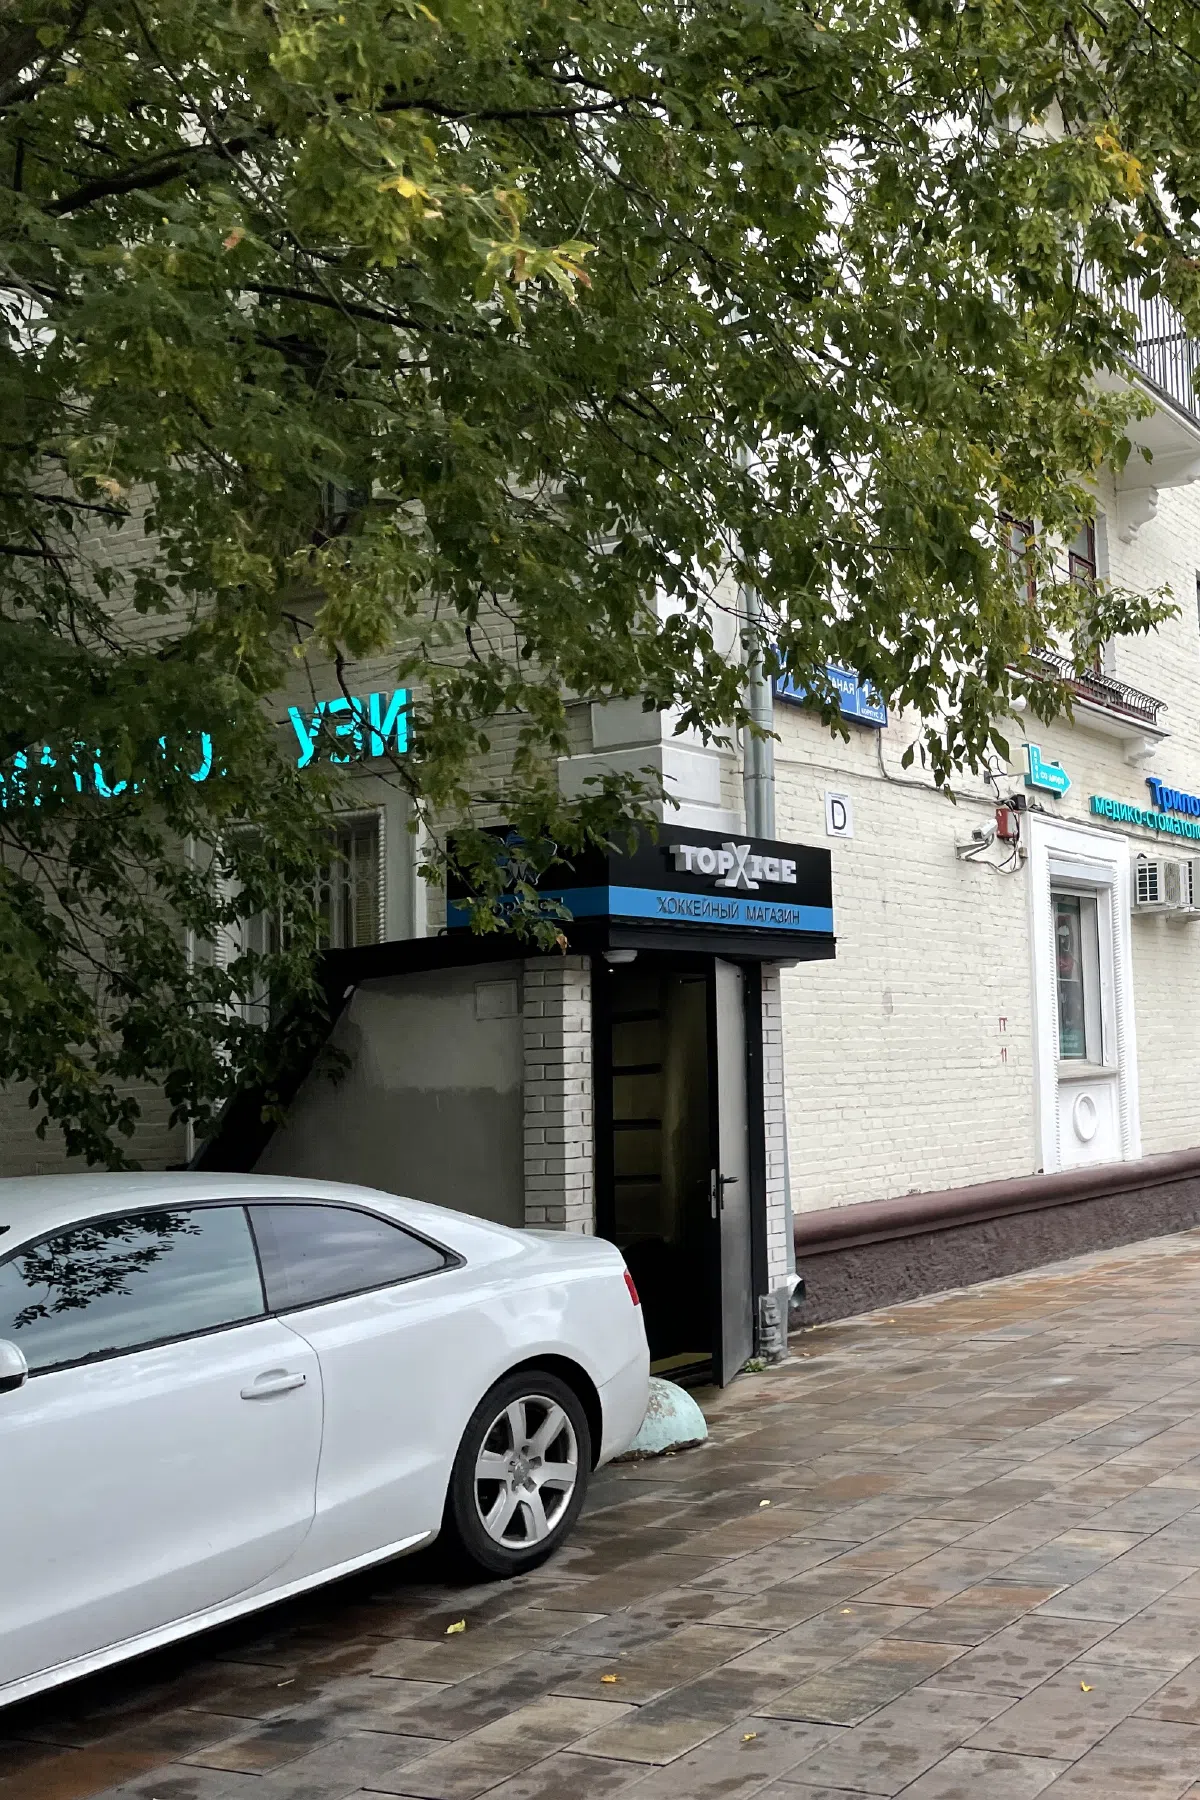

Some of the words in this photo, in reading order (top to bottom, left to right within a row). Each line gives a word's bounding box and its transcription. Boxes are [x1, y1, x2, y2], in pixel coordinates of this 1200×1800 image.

[287, 687, 412, 769] УЗИ
[656, 896, 739, 920] ХОККЕЙНЫЙ
[746, 905, 800, 925] МАГАЗИН
